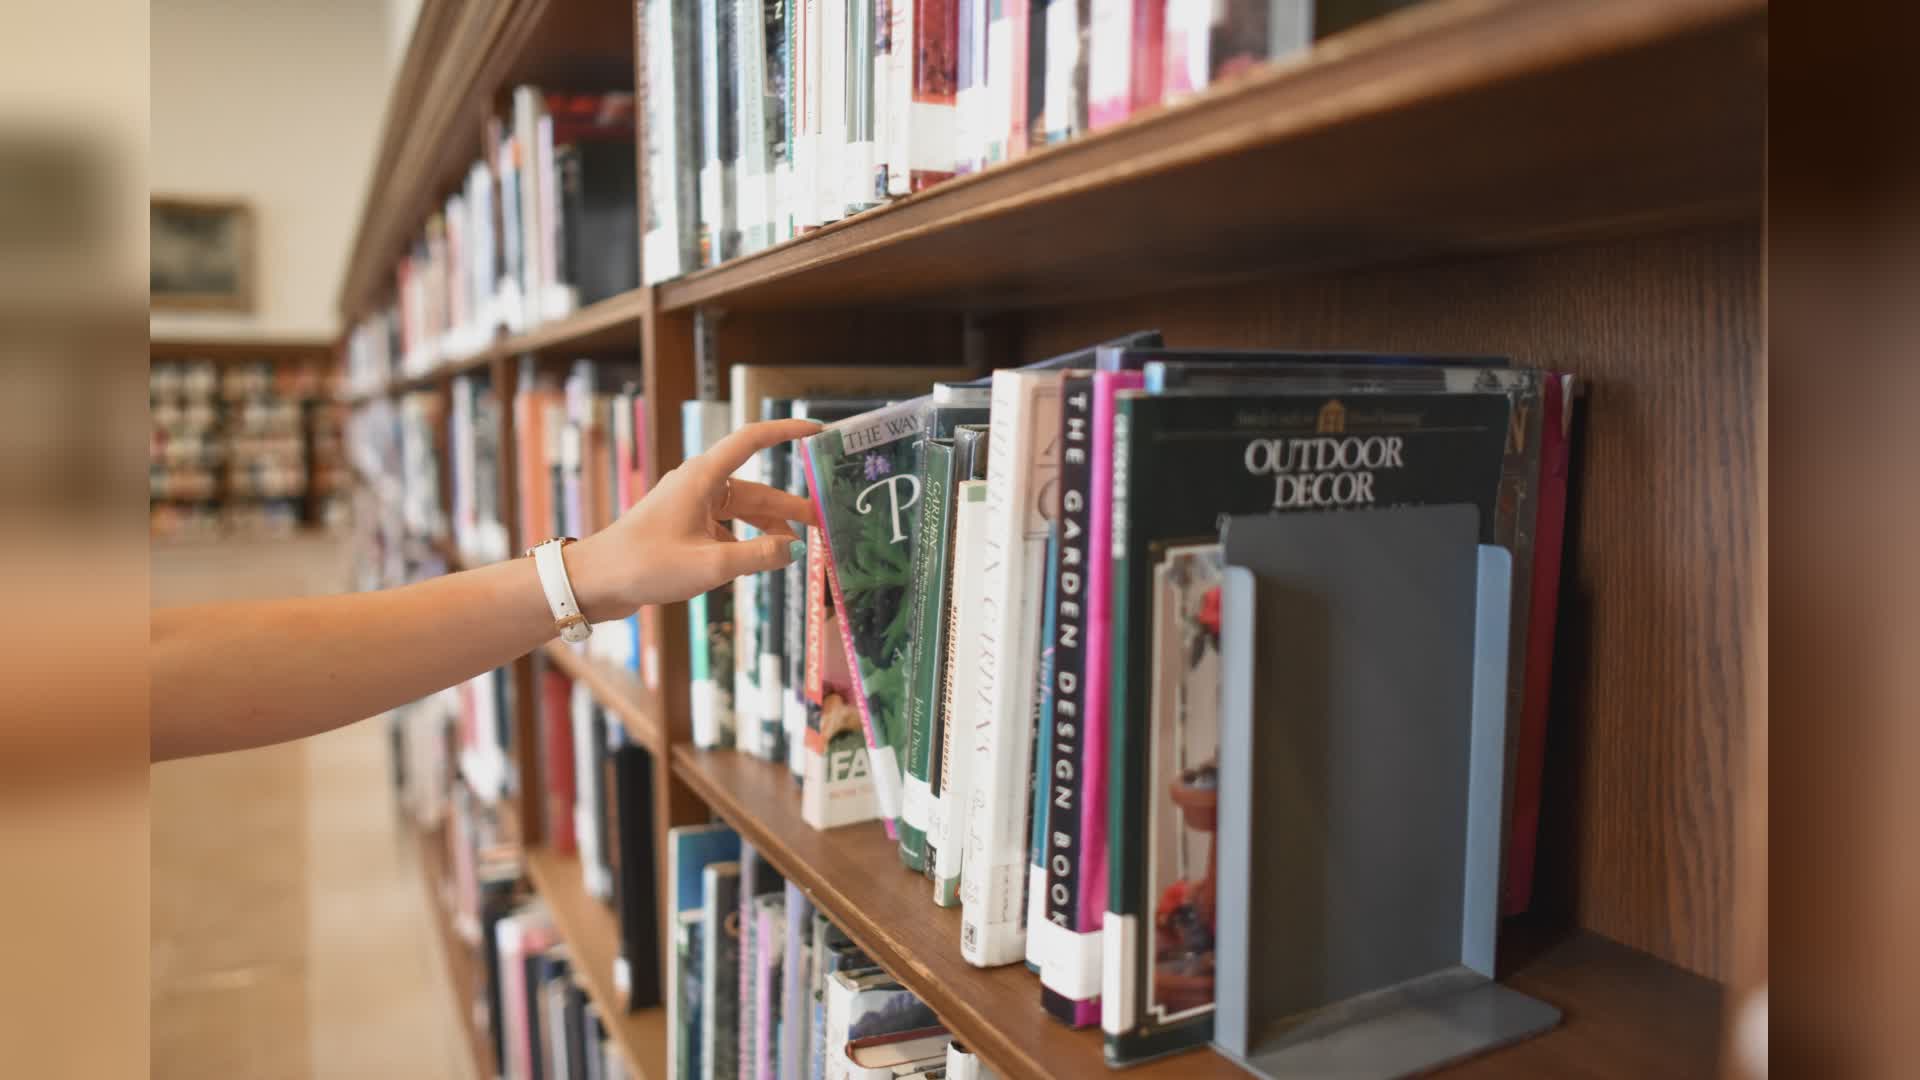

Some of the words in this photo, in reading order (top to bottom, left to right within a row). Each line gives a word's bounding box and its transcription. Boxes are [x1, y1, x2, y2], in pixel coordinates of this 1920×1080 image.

[844, 427, 882, 450] THE
[886, 414, 920, 436] WAY
[1067, 391, 1087, 465] THE
[1244, 435, 1404, 475] OUTDOOR
[928, 480, 942, 552] GARDEN
[1273, 471, 1375, 508] DECOR
[1061, 488, 1083, 648] GARDEN
[1054, 671, 1077, 811] DESIGN
[1051, 830, 1071, 928] BOOK
